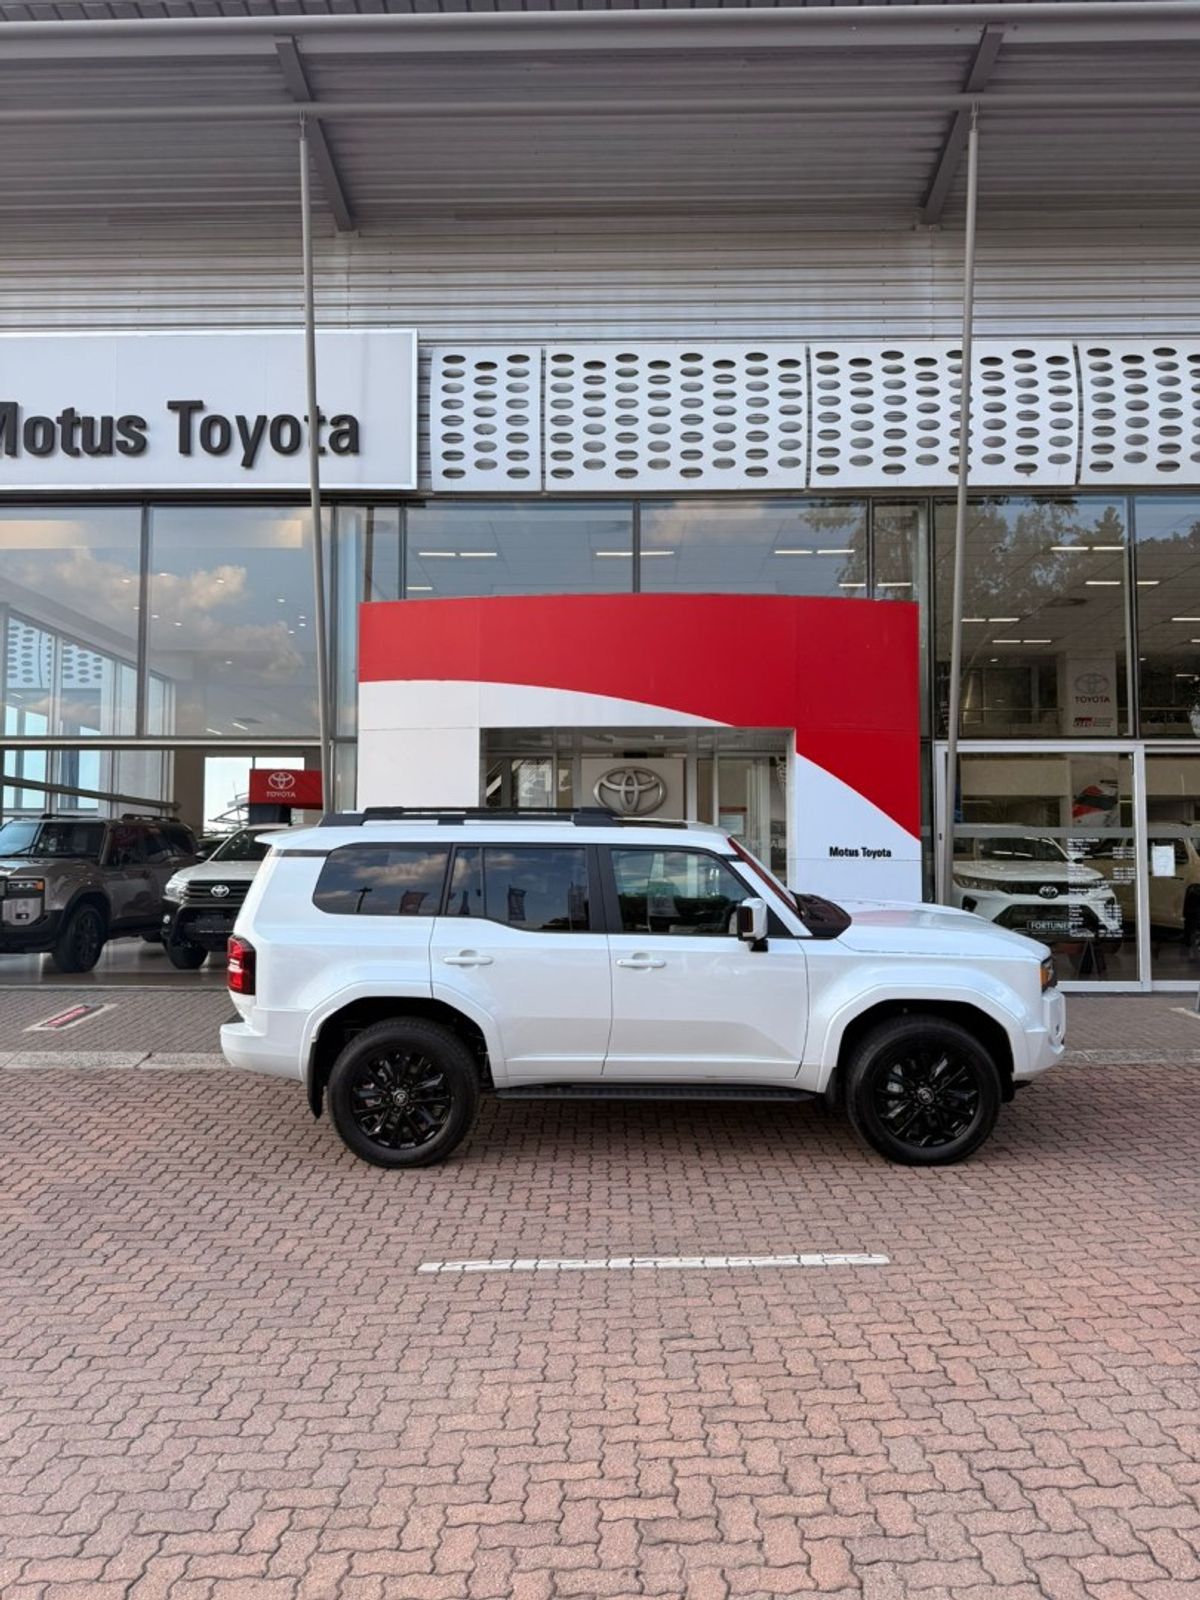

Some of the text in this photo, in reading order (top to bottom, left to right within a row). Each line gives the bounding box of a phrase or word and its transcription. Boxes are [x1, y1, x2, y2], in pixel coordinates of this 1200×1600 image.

[1075, 696, 1111, 704] TOYOTA
[829, 846, 892, 859] Motus Toyota
